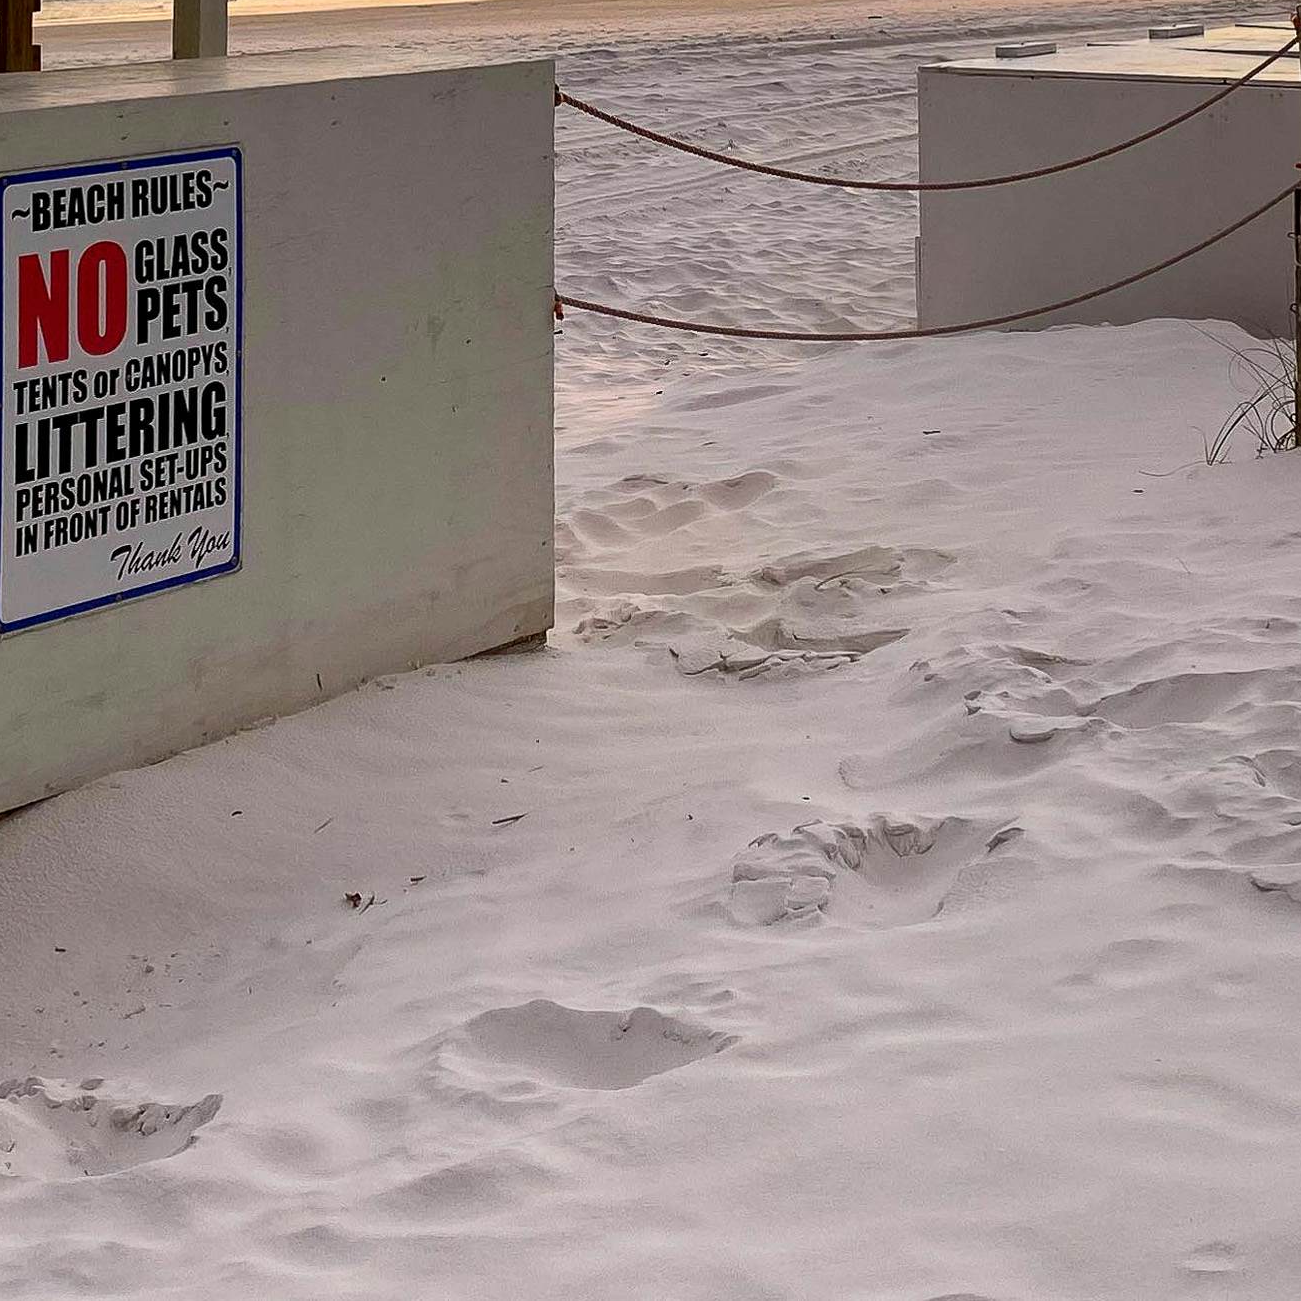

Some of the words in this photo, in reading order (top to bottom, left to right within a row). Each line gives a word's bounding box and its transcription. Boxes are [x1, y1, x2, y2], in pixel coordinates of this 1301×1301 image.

[134, 227, 232, 284] GLASS,
[18, 240, 128, 369] NO
[136, 275, 230, 345] PETS,
[13, 369, 87, 415] TENTS
[93, 368, 120, 399] or
[15, 524, 38, 557] IN
[44, 506, 111, 550] FRONT
[115, 499, 140, 531] OF
[145, 477, 227, 524] RENTALS
[16, 464, 134, 522] PERSONAL
[139, 442, 227, 492] SET-UPS
[110, 532, 183, 580] Thank
[187, 526, 230, 568] You
